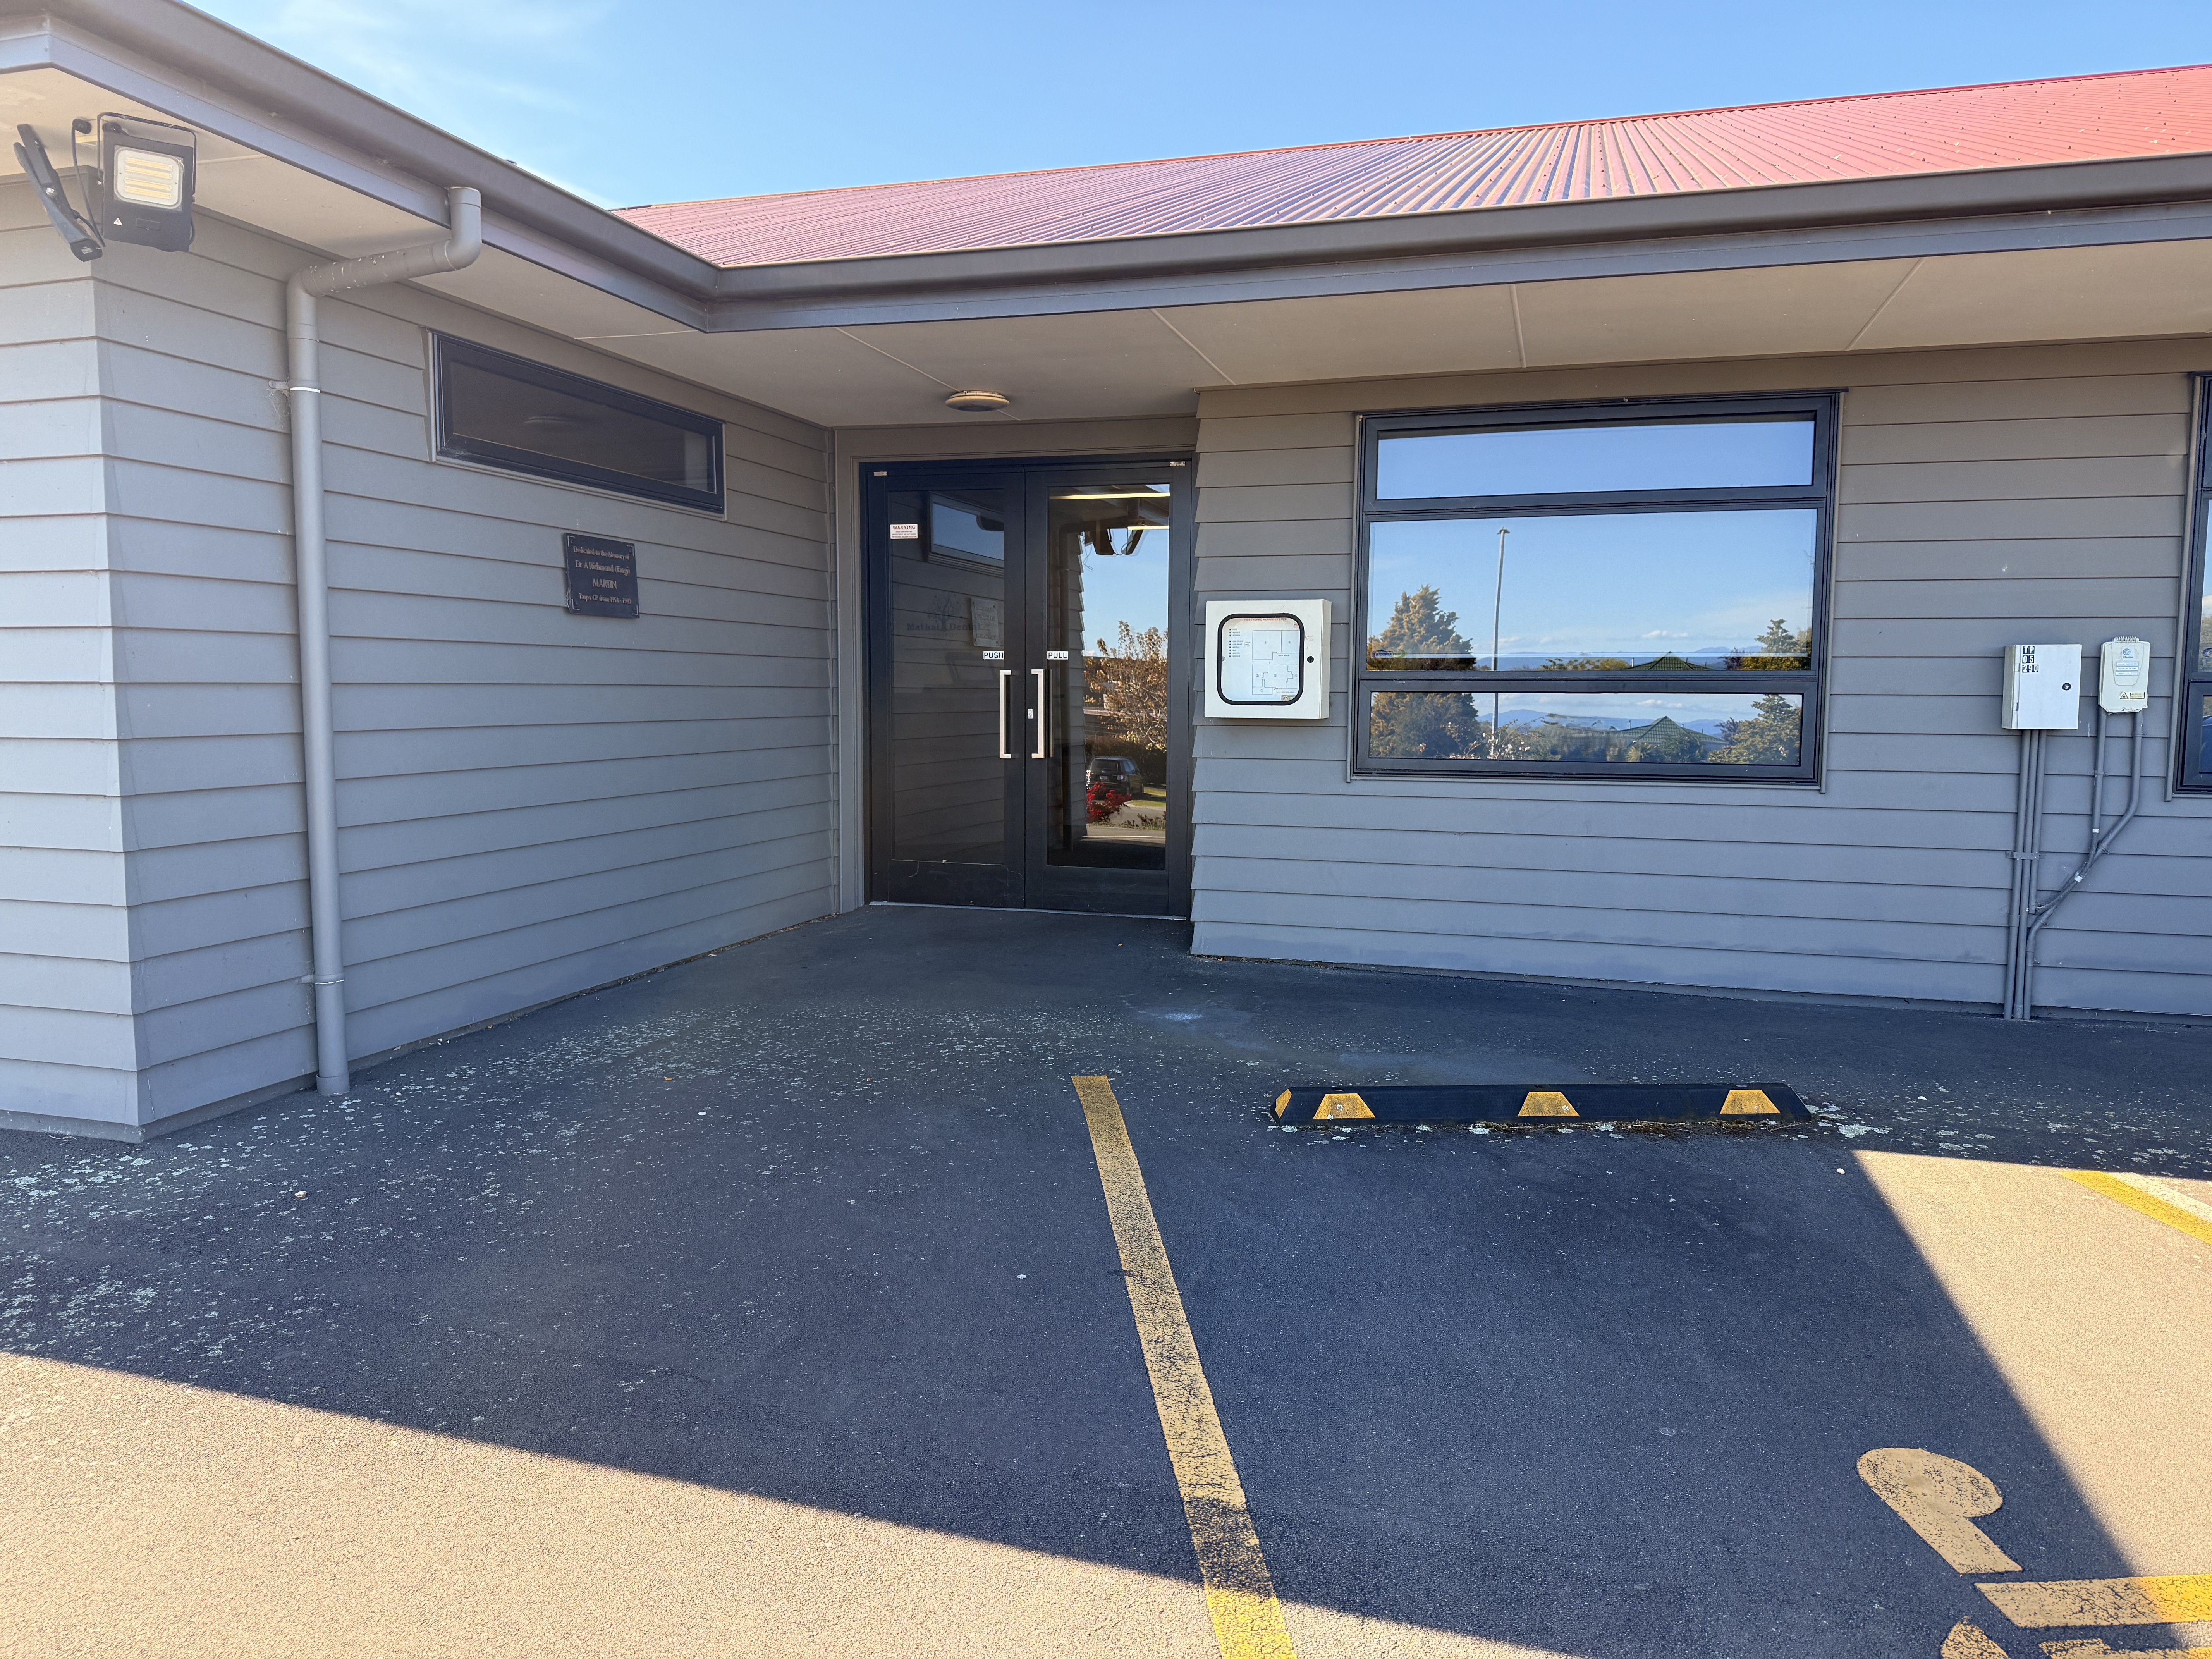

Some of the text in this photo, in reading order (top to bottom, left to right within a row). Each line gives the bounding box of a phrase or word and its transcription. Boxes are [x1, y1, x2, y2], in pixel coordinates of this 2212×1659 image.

[573, 546, 595, 555] Dedicated
[593, 578, 617, 589] MARTIN
[907, 623, 981, 631] Mathai Dental
